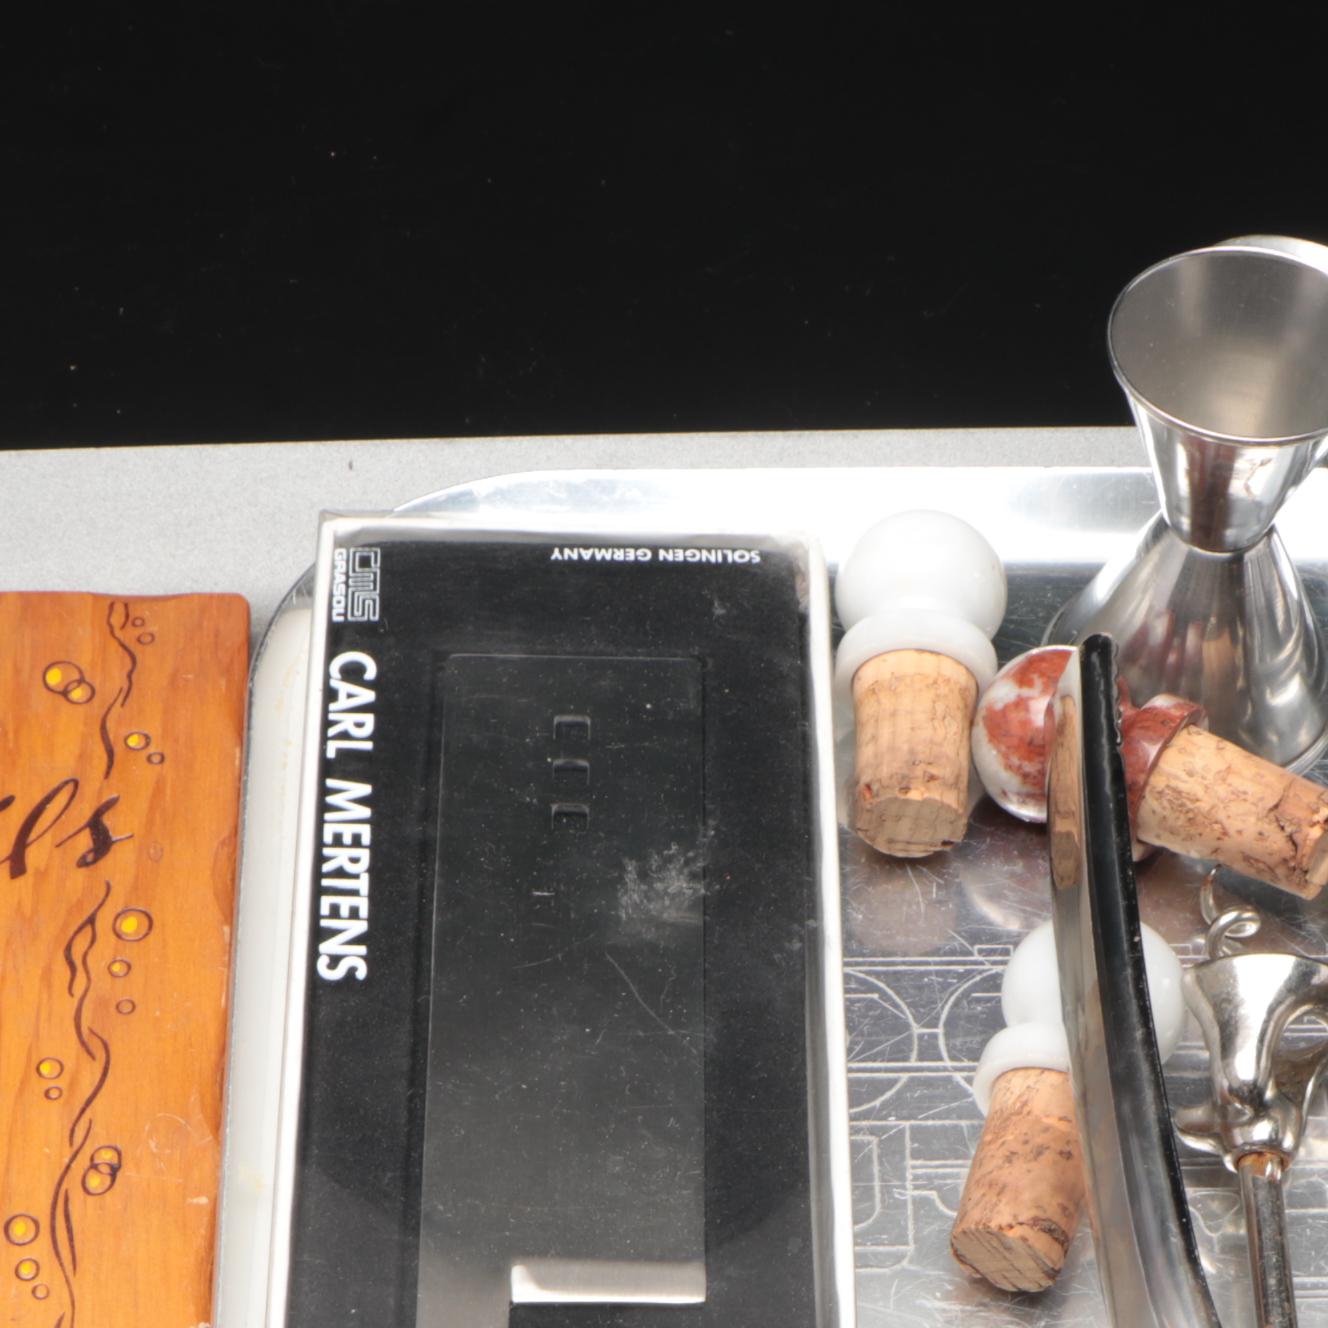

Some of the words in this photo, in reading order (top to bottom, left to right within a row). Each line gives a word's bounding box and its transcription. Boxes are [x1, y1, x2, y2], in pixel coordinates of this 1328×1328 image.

[551, 548, 651, 562] GERMANY
[658, 549, 761, 563] SOLINGEN
[327, 651, 377, 758] CARL
[317, 779, 372, 982] MERTENS
